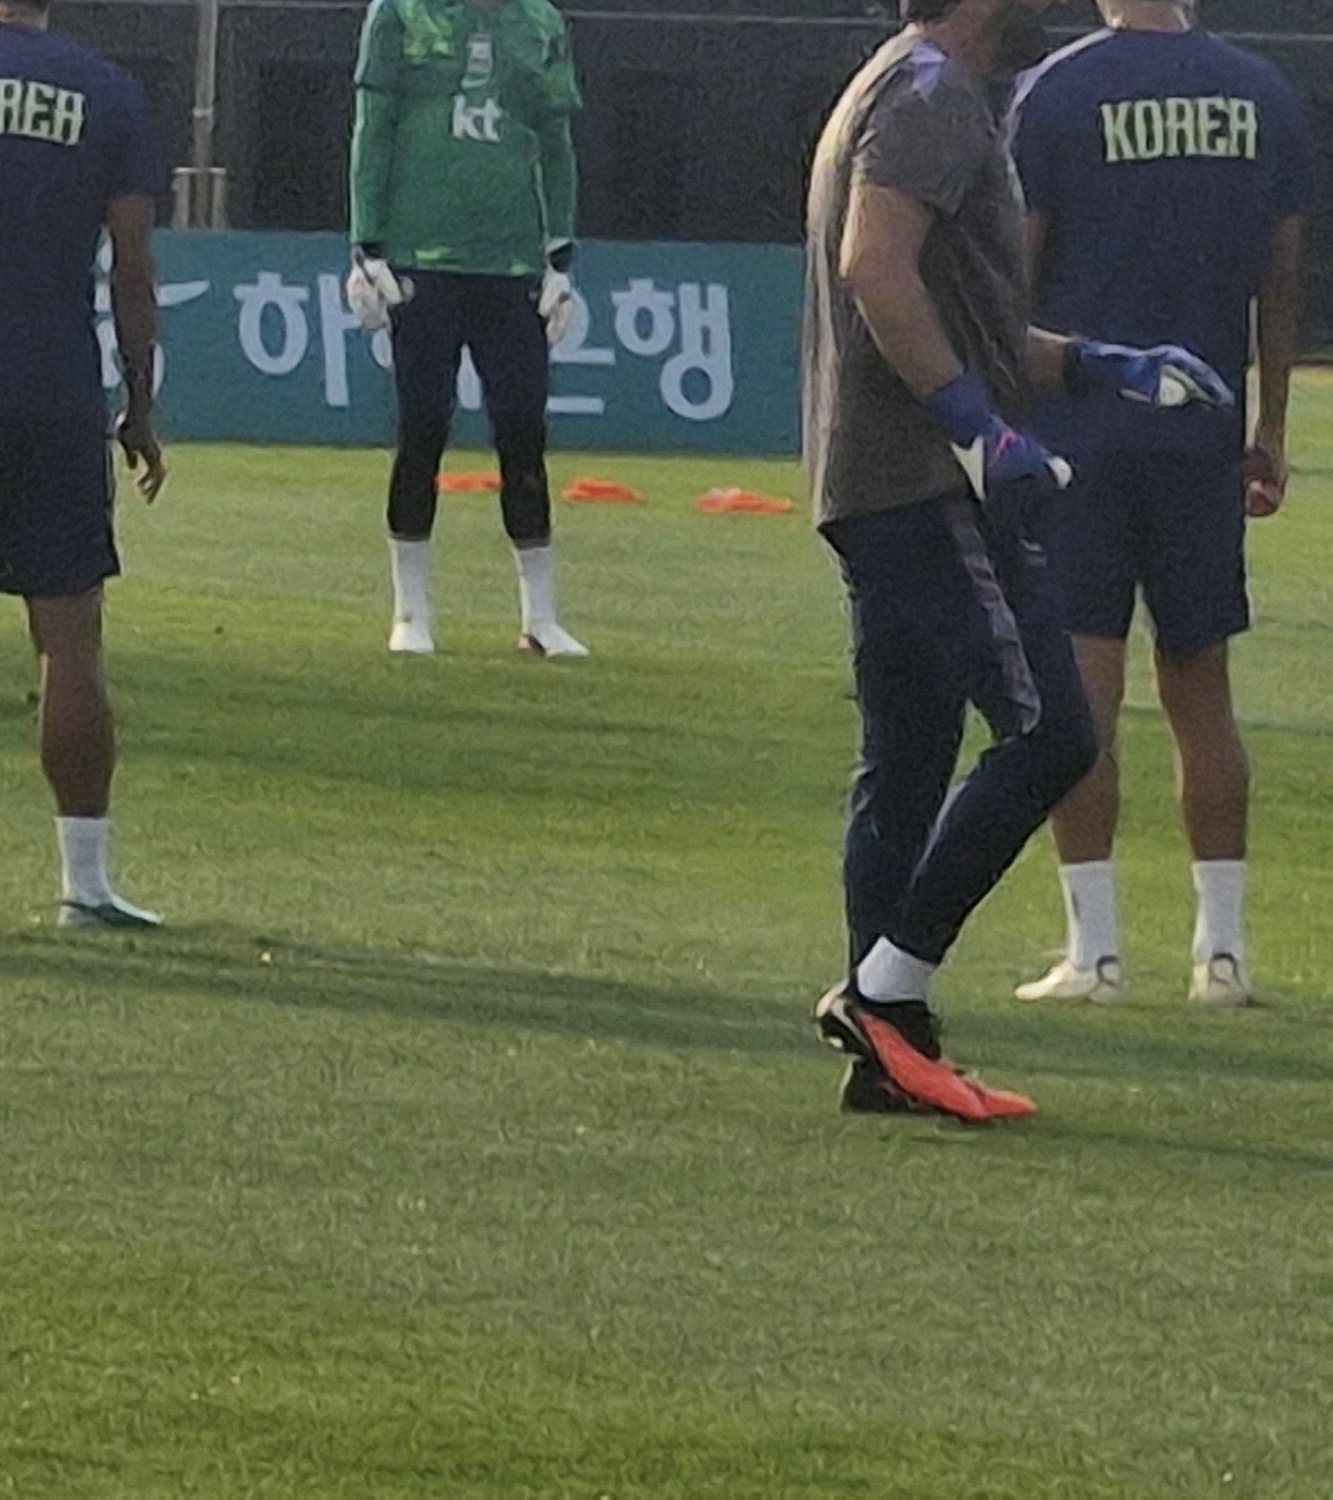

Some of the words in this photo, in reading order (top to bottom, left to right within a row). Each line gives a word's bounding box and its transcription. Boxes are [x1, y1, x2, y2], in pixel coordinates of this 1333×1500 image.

[452, 94, 503, 143] kt
[1100, 96, 1258, 162] KOREA
[233, 271, 733, 421] 하은행
